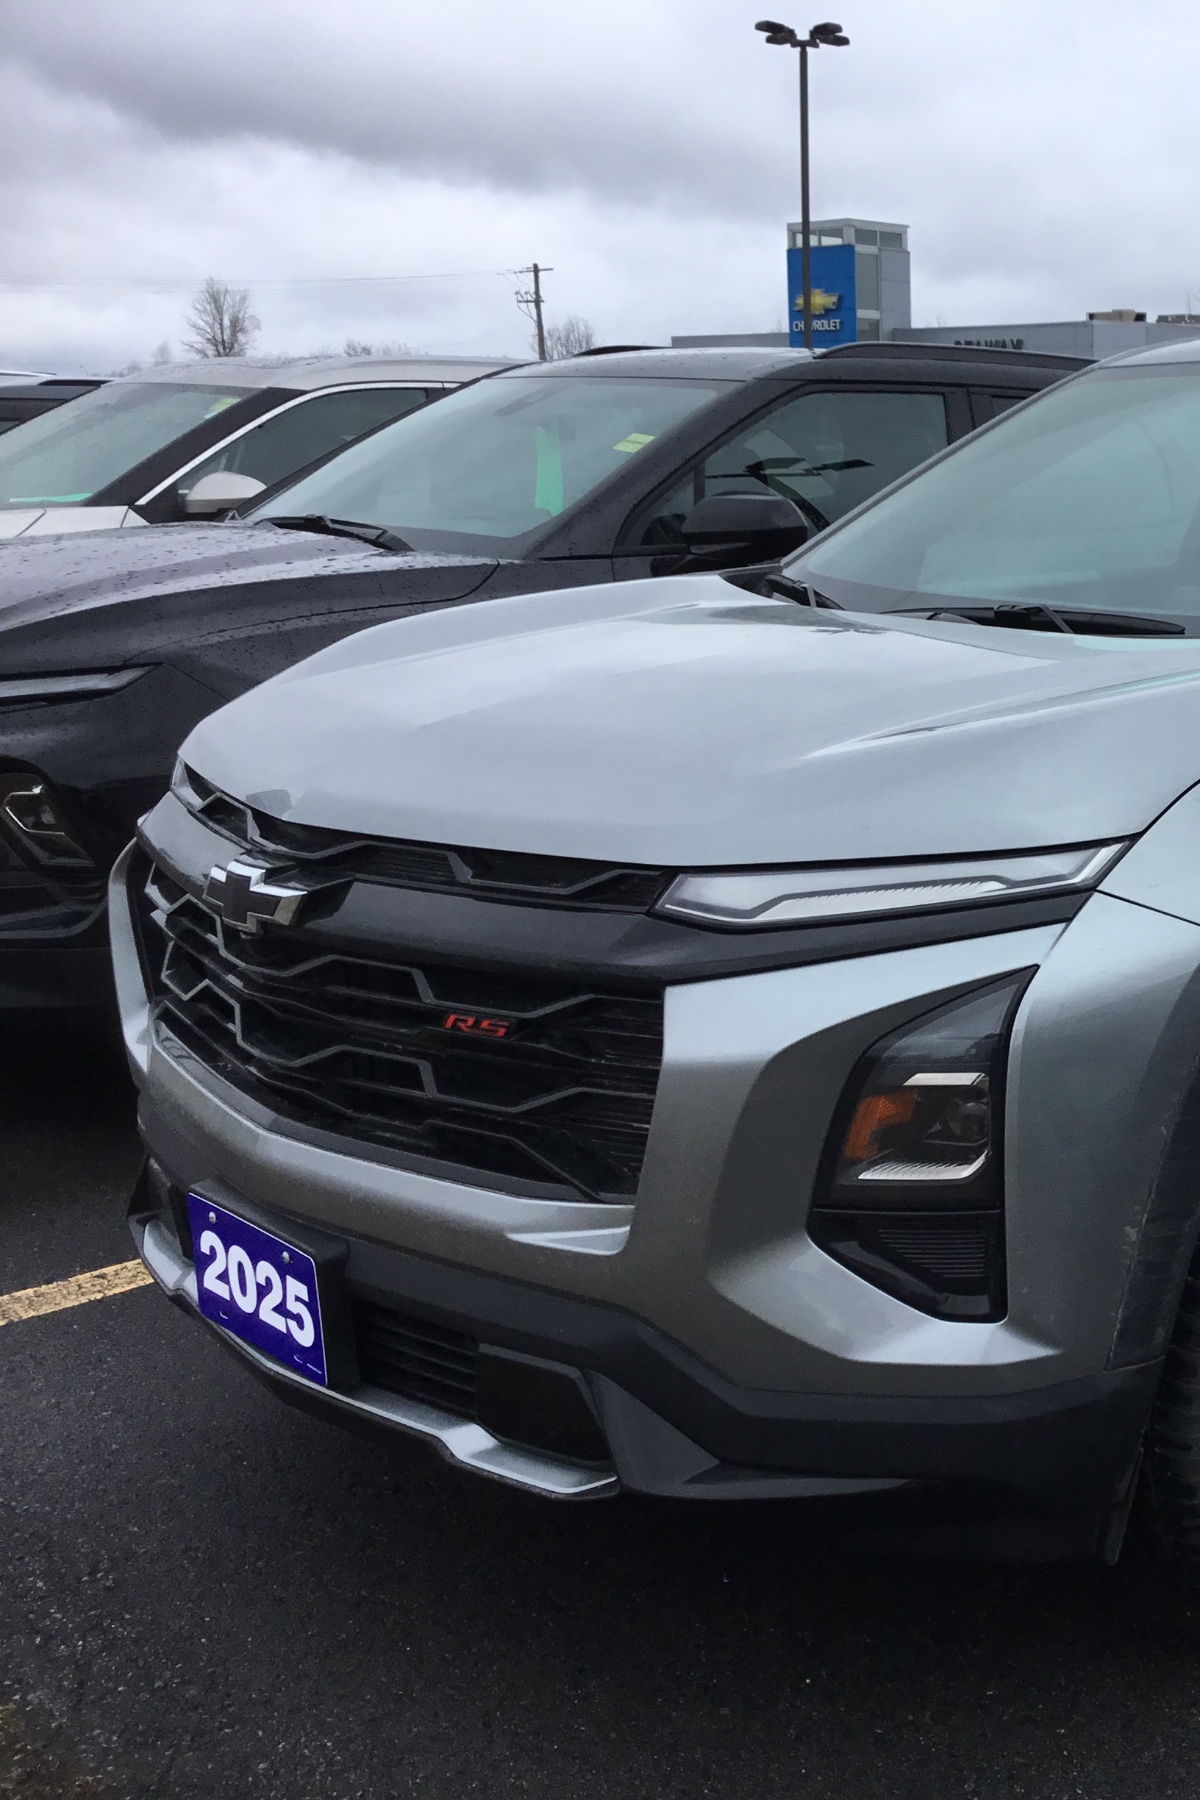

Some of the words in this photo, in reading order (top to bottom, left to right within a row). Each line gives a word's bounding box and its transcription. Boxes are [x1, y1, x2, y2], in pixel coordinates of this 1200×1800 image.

[793, 319, 841, 332] CHVROLET
[443, 1013, 510, 1037] RS
[200, 1230, 315, 1348] 2025
